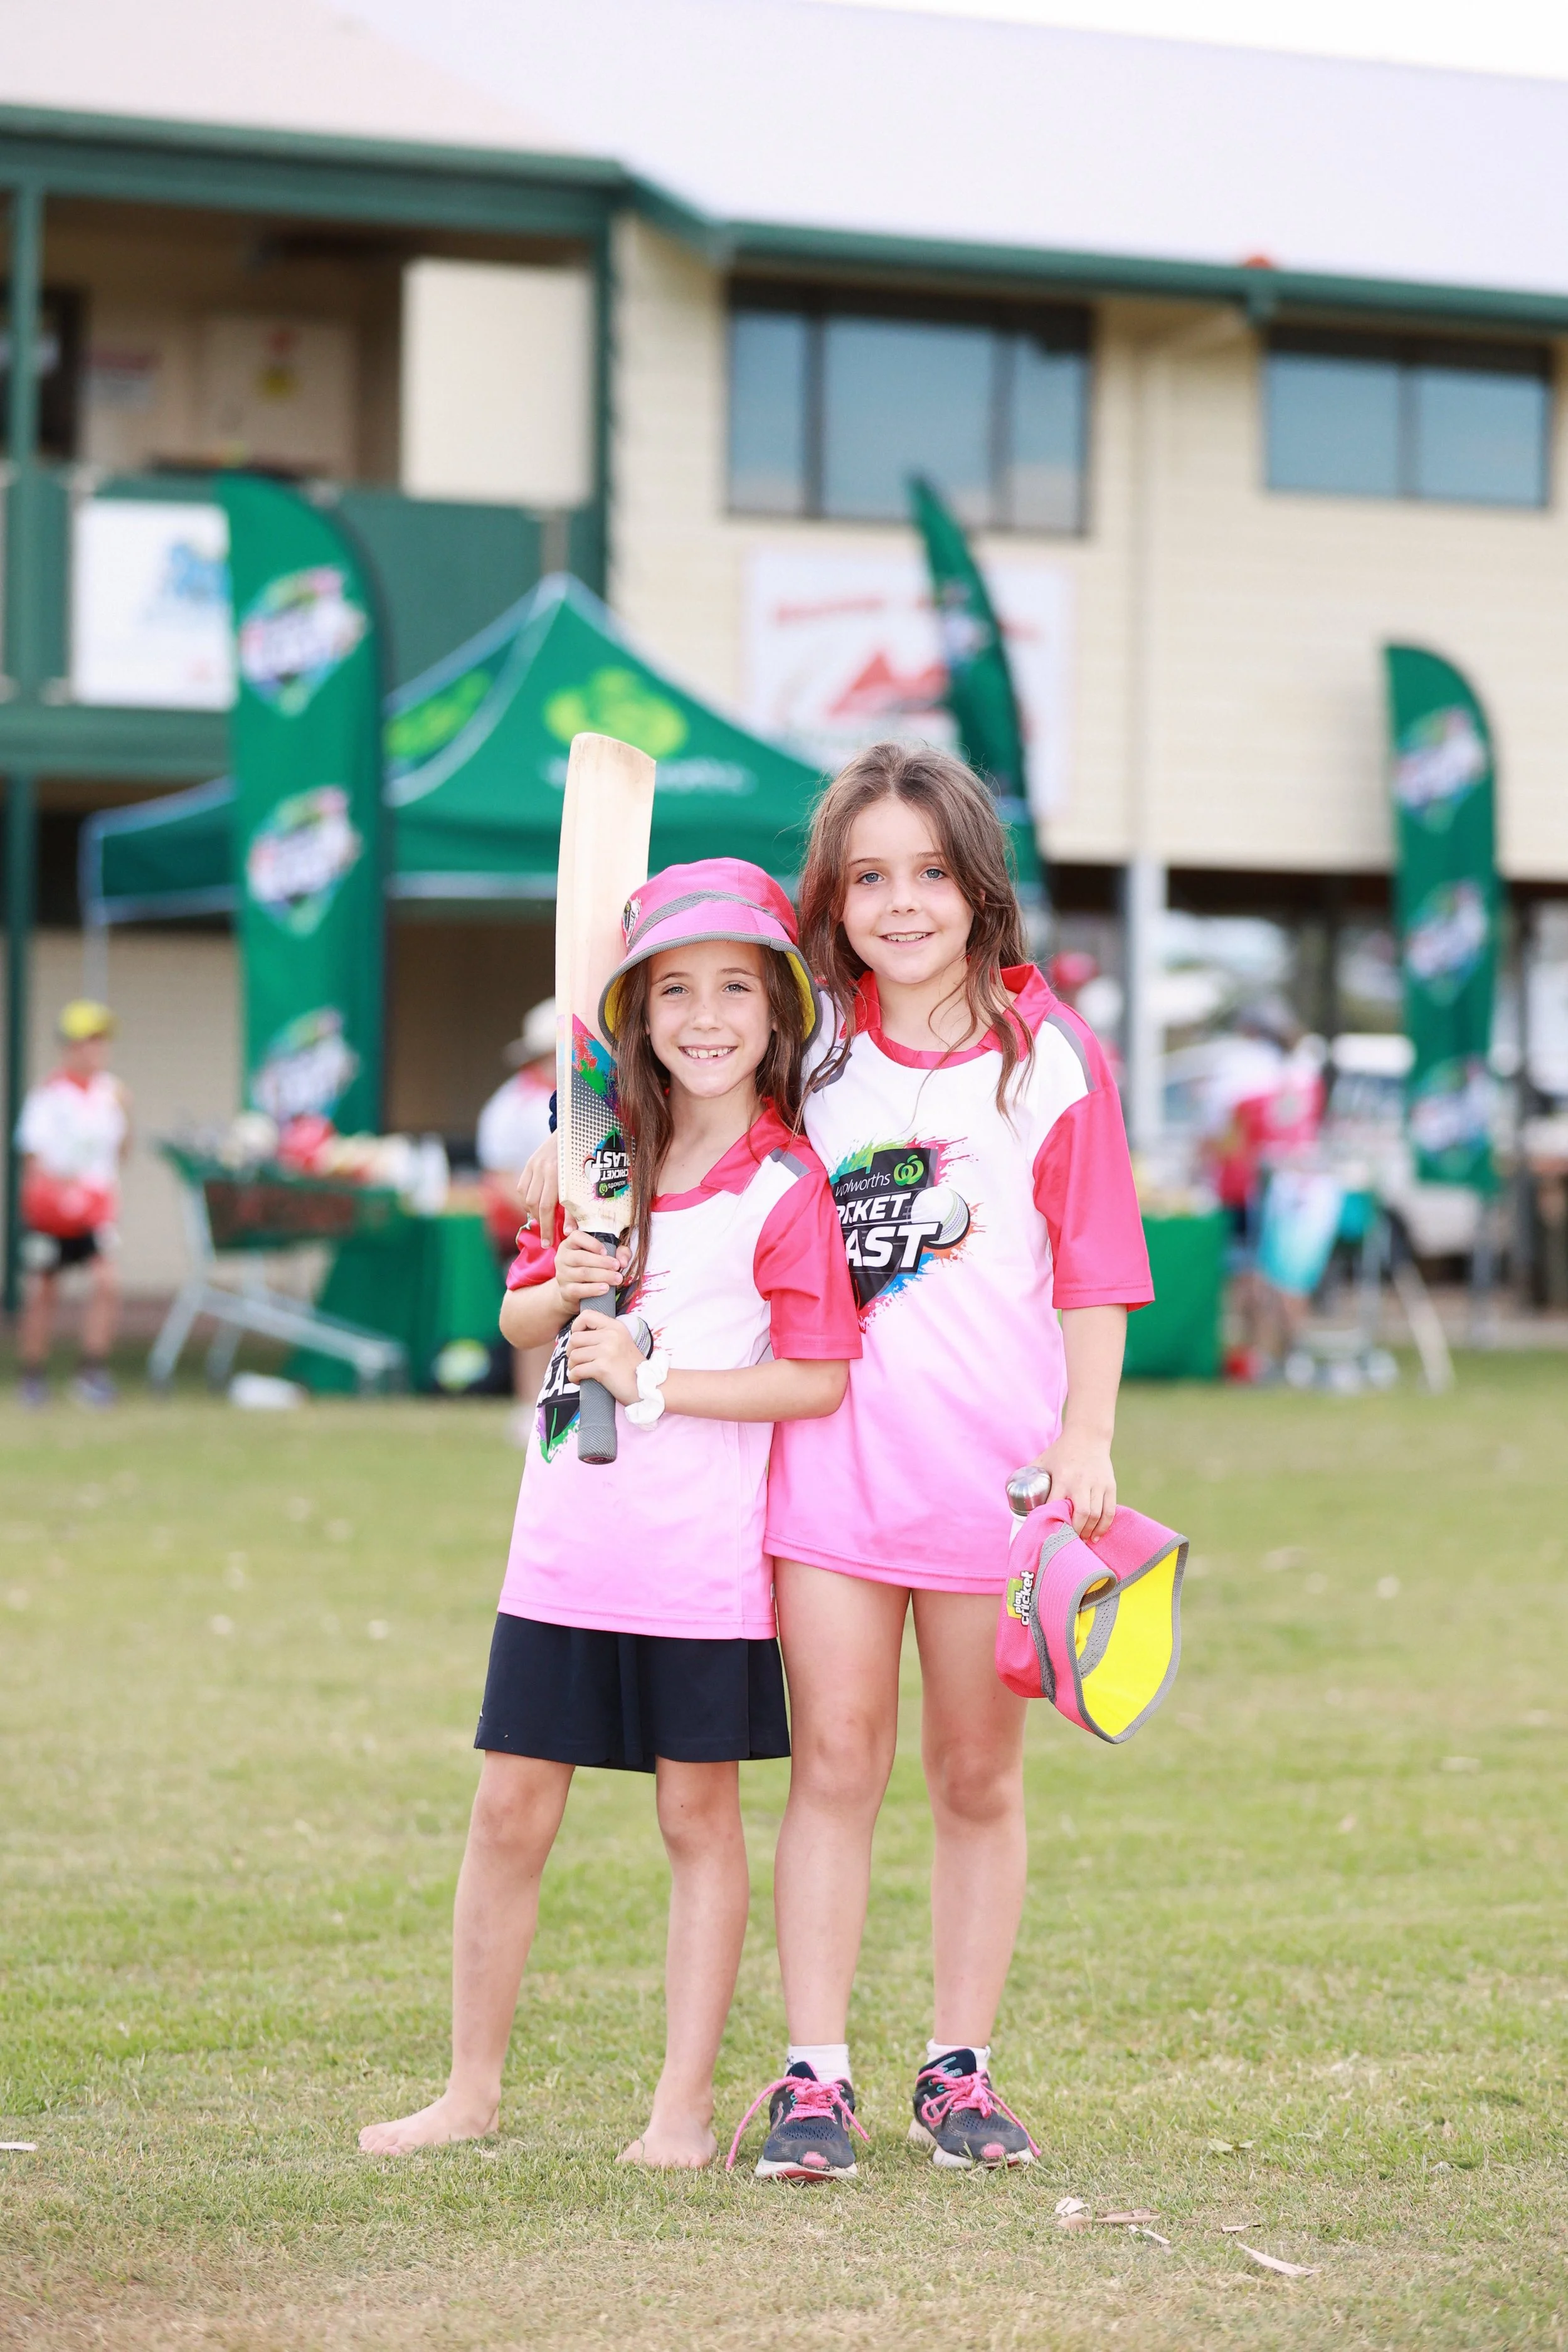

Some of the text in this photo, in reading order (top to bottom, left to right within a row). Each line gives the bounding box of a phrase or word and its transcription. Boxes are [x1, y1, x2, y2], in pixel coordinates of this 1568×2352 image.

[601, 1168, 628, 1181] CRICKET
[608, 1180, 626, 1189] woolworths
[835, 1172, 891, 1197] wolworths
[835, 1192, 912, 1224] RICKET
[845, 1222, 941, 1268] AST
[1014, 1591, 1023, 1614] play
[1021, 1571, 1035, 1626] cricket
